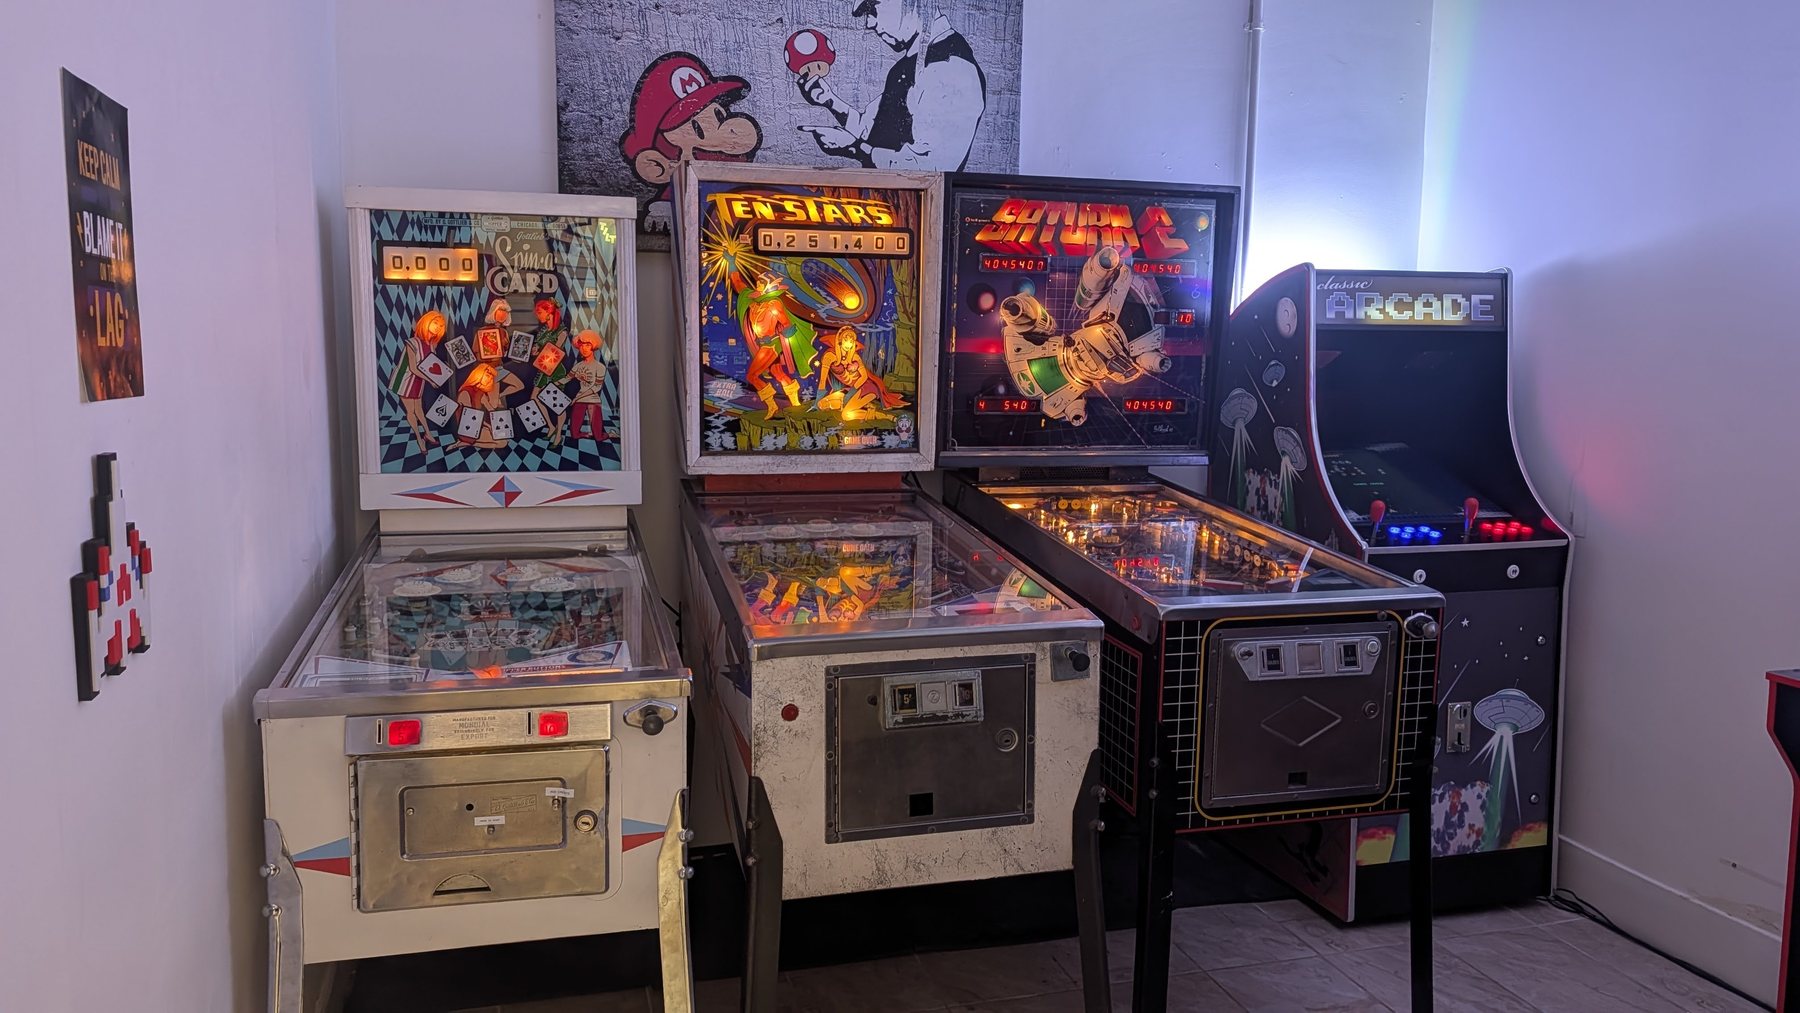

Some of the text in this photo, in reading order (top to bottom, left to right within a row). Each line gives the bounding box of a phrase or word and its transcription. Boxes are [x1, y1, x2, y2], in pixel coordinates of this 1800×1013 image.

[77, 139, 121, 191] KEEP CALM
[706, 192, 893, 229] TEN STARS
[83, 210, 123, 261] BLAME IT
[514, 231, 550, 243] Gottlieb's
[599, 221, 617, 244] TILT
[487, 267, 559, 296] CARD
[1317, 276, 1372, 290] classic
[1325, 291, 1495, 320] ARCADE
[94, 289, 125, 348] LAG
[712, 382, 737, 390] EXTRA
[716, 389, 734, 398] BALL
[1125, 400, 1172, 410] 404540
[844, 436, 861, 445] GAME
[458, 721, 490, 729] MONDIAL
